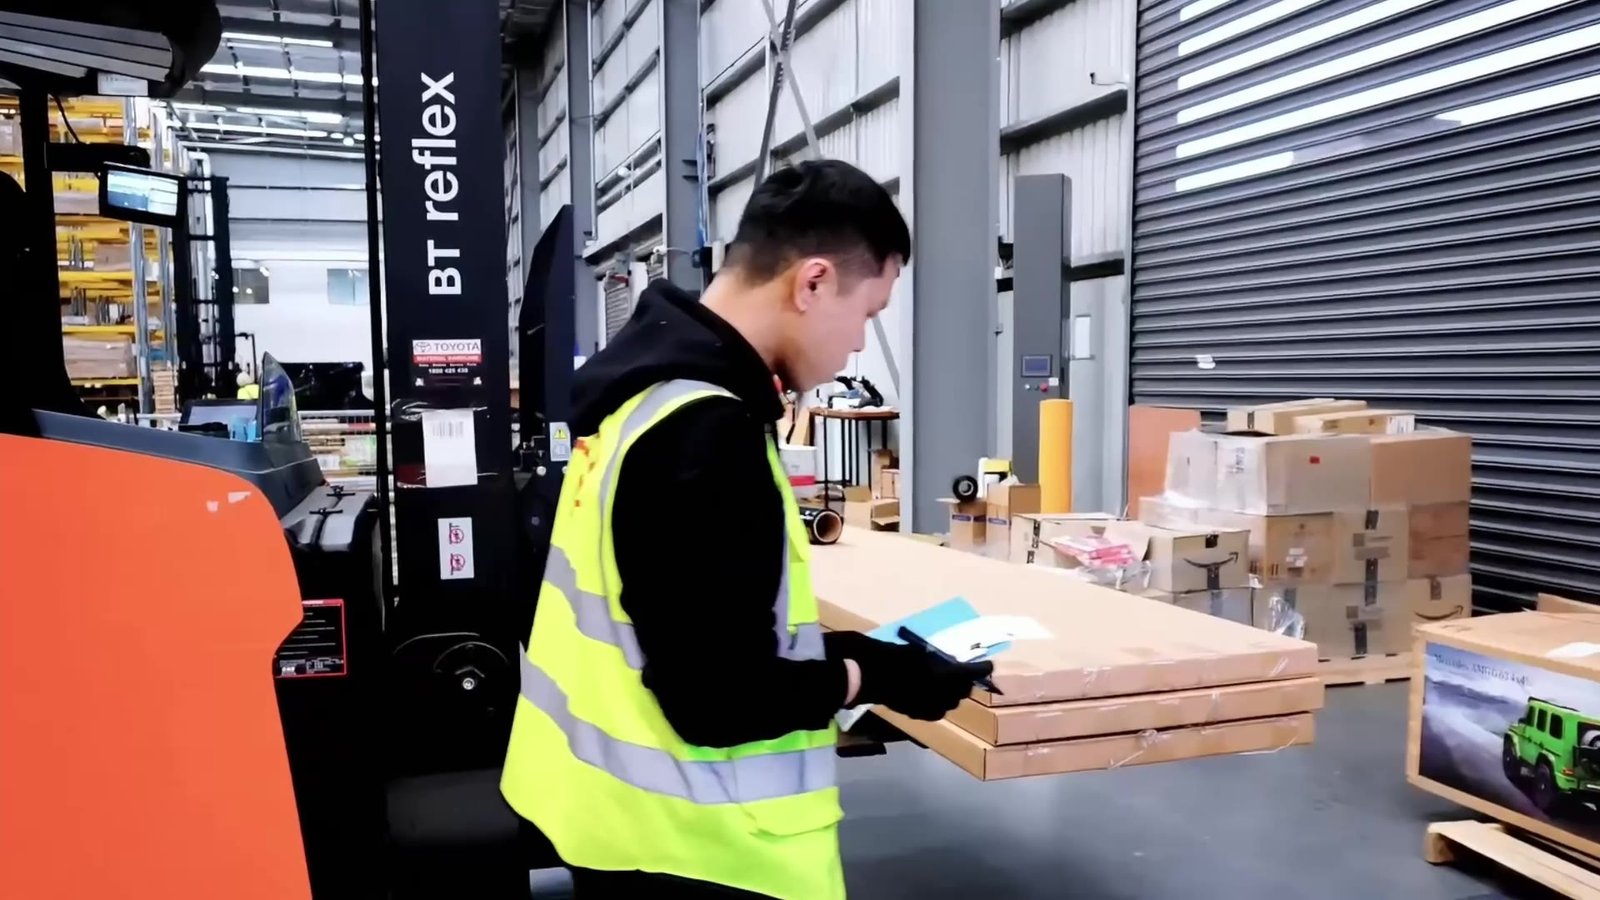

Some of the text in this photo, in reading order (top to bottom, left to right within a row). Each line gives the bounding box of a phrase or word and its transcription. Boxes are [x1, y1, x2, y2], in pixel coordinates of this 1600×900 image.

[411, 72, 462, 295] BT reflex
[434, 342, 480, 351] TOYOTA
